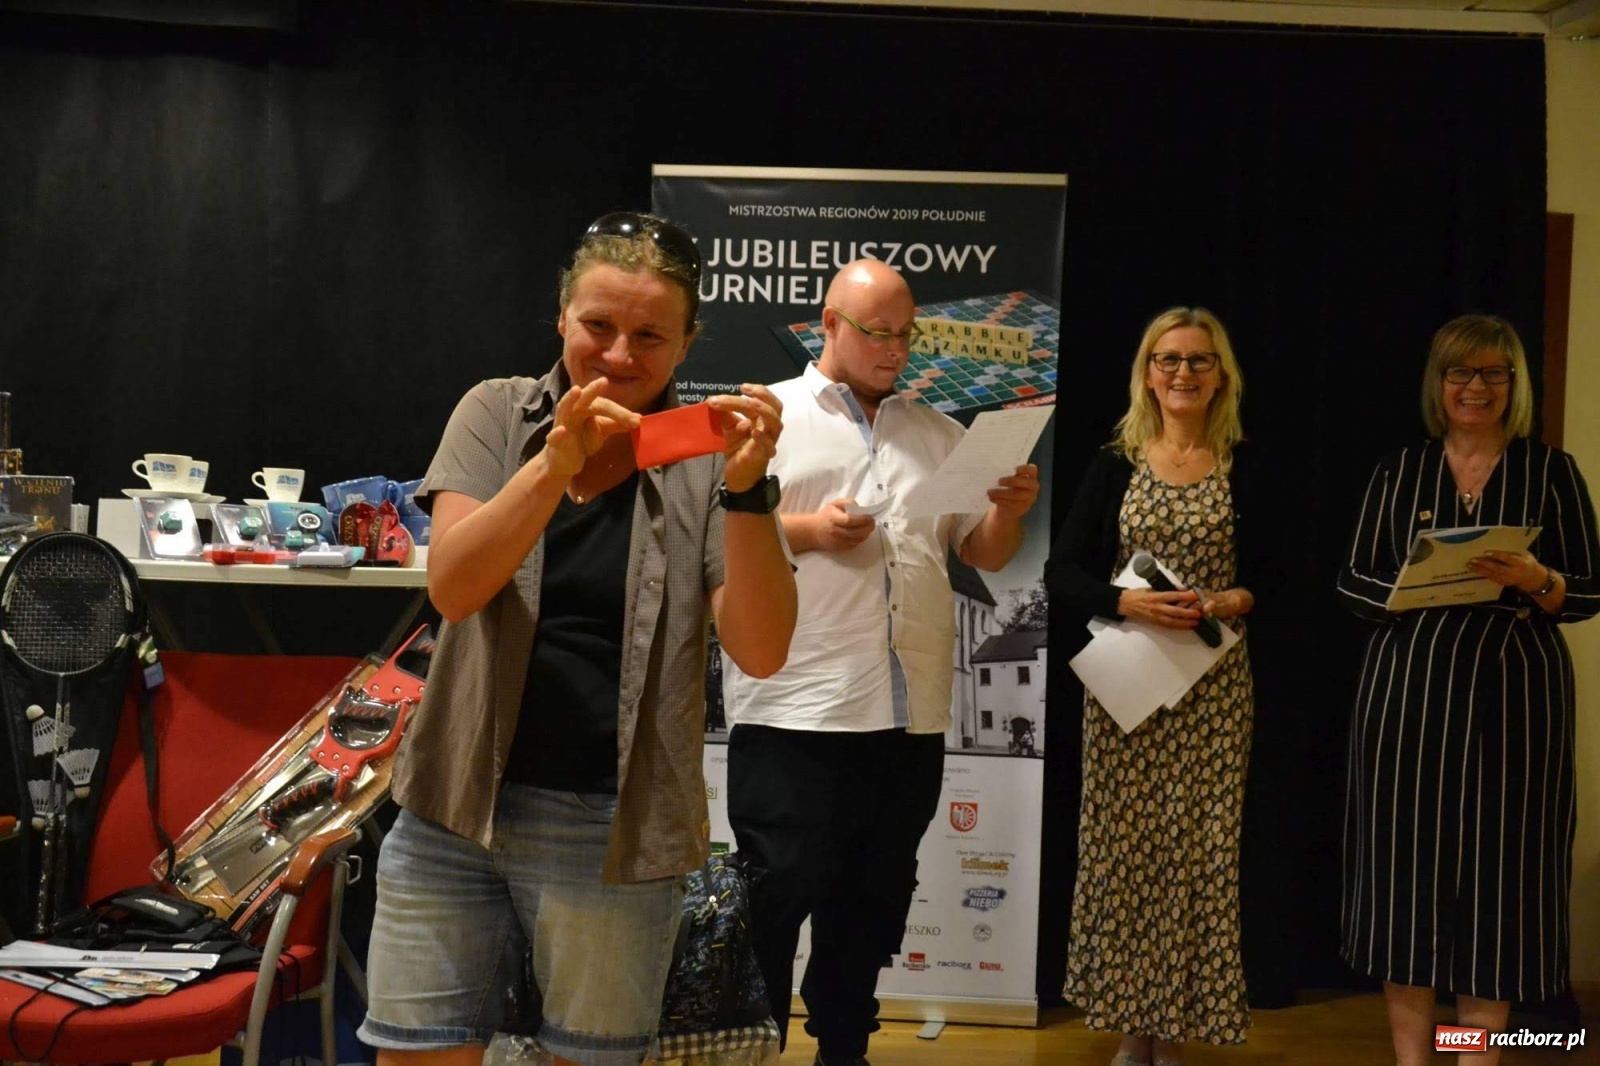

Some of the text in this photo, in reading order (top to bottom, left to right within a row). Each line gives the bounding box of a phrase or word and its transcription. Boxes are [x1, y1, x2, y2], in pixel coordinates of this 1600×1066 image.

[728, 205, 986, 222] MISTRZOSTWA REGIONÓW 2019 POŁUDNIE
[707, 238, 997, 274] JUBILEUSZOWY
[698, 273, 823, 305] URNIEJ
[930, 322, 1025, 343] RABBLE
[943, 340, 1021, 360] ZAMKU
[675, 380, 688, 390] od
[22, 485, 61, 495] TRONU
[344, 515, 354, 546] ESZKO
[904, 924, 941, 936] IESZKO
